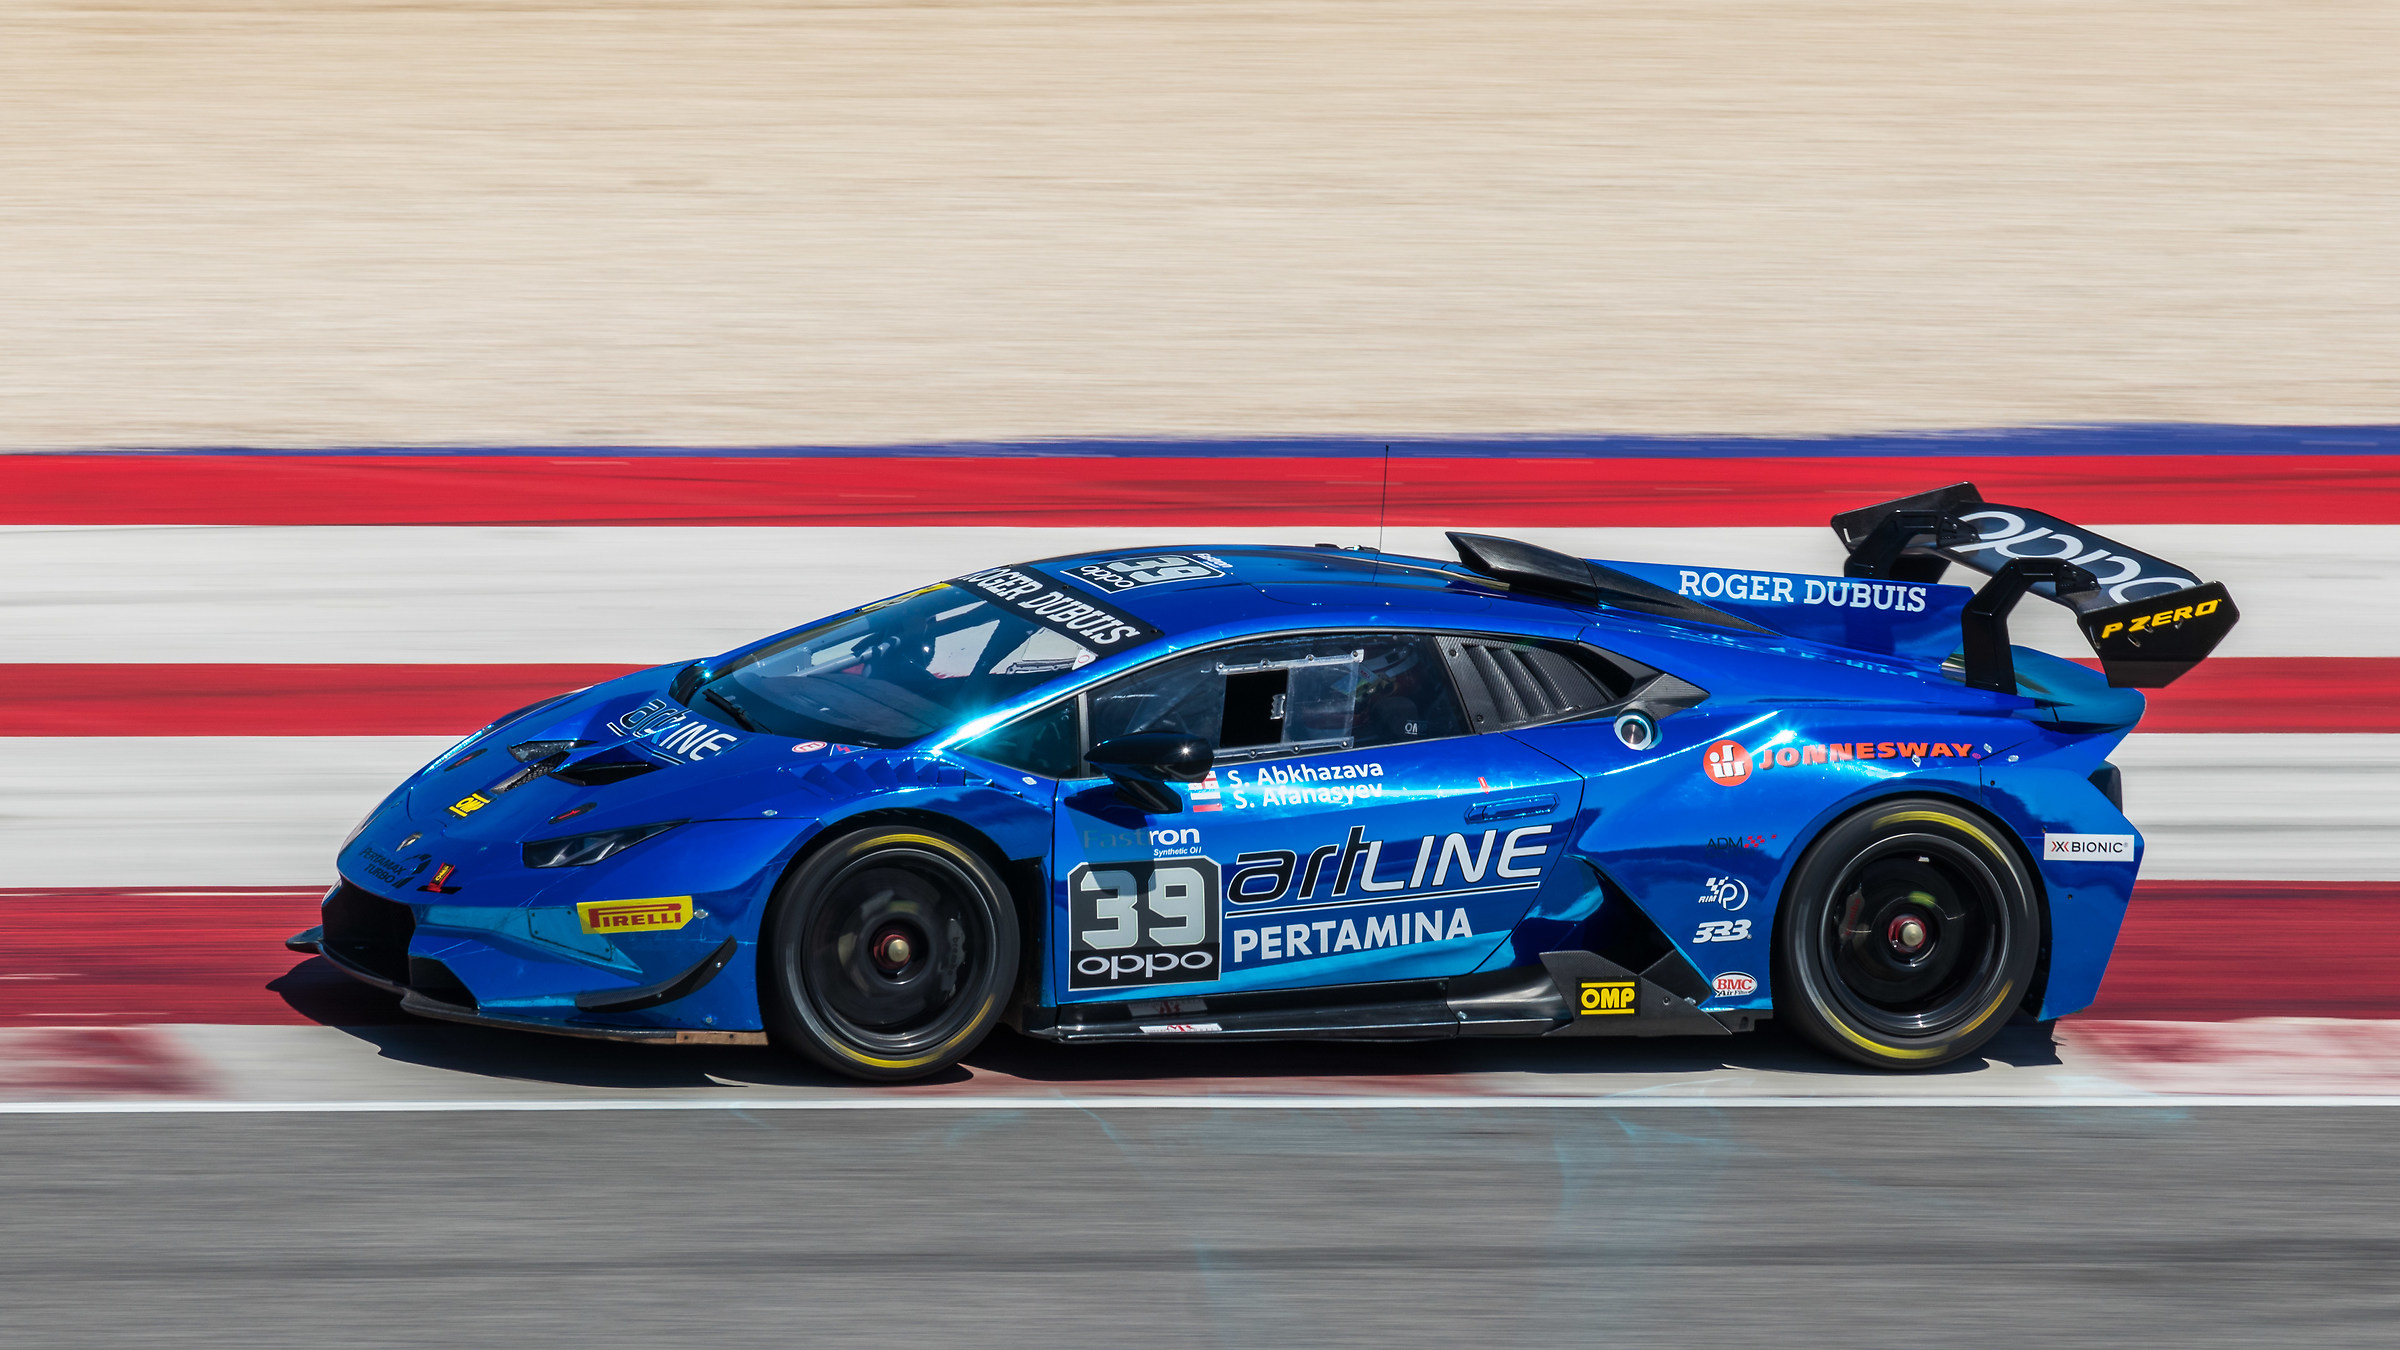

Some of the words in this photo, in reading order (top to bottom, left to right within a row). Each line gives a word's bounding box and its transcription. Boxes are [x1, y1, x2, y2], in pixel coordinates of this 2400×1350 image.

[1080, 566, 1135, 588] oppo
[1106, 556, 1212, 583] 39
[1678, 570, 1794, 603] ROGER
[1803, 579, 1926, 612] DUBUIS
[1018, 591, 1141, 644] DUBUIS
[2101, 621, 2123, 639] P
[2128, 599, 2220, 633] ZERO
[1759, 742, 1973, 770] JONNESWAY
[1227, 769, 1250, 789] S.
[1257, 762, 1384, 787] Abkhazava
[455, 797, 485, 813] OMP
[1233, 789, 1255, 810] S.
[1262, 783, 1383, 807] Afanasyev
[1083, 828, 1200, 849] Fastron
[1153, 847, 1188, 857] Synthetic
[1190, 846, 1202, 854] Oil
[1706, 836, 1743, 849] ADM
[359, 847, 407, 876] PERTAMAX
[363, 863, 396, 884] TURBO
[1227, 825, 1553, 905] artLINE
[588, 903, 682, 928] PIRELLI
[1080, 867, 1205, 950] 39
[1233, 908, 1473, 962] PERTAMINA
[1692, 919, 1752, 943] 333
[1077, 951, 1213, 980] oppo
[1581, 987, 1635, 1009] OMP
[1717, 979, 1752, 990] BMC
